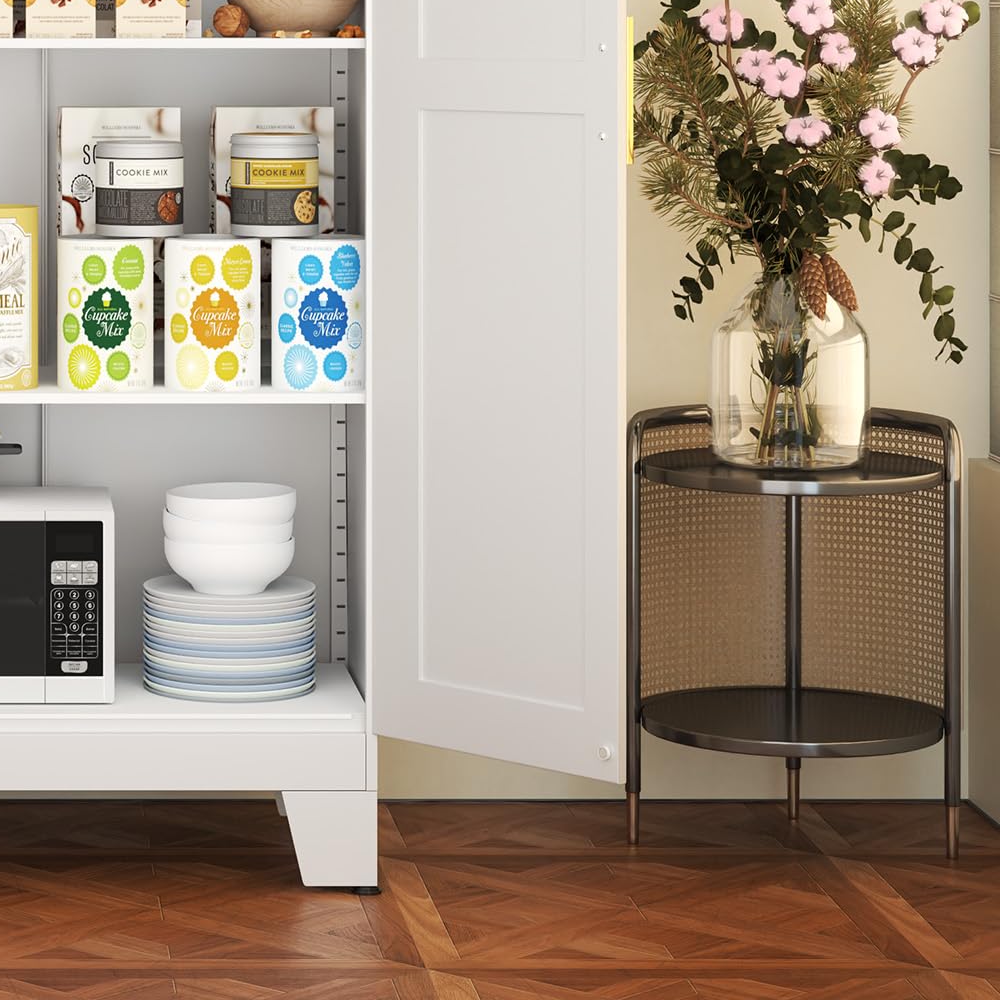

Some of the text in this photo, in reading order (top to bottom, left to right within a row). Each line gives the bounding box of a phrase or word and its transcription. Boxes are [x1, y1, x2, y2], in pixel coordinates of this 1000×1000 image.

[84, 306, 128, 324] Cupcake
[192, 306, 237, 324] Cupcake
[301, 306, 345, 324] Cupcake
[96, 322, 124, 337] Mix
[204, 322, 232, 337] Mix
[313, 322, 341, 337] Mix
